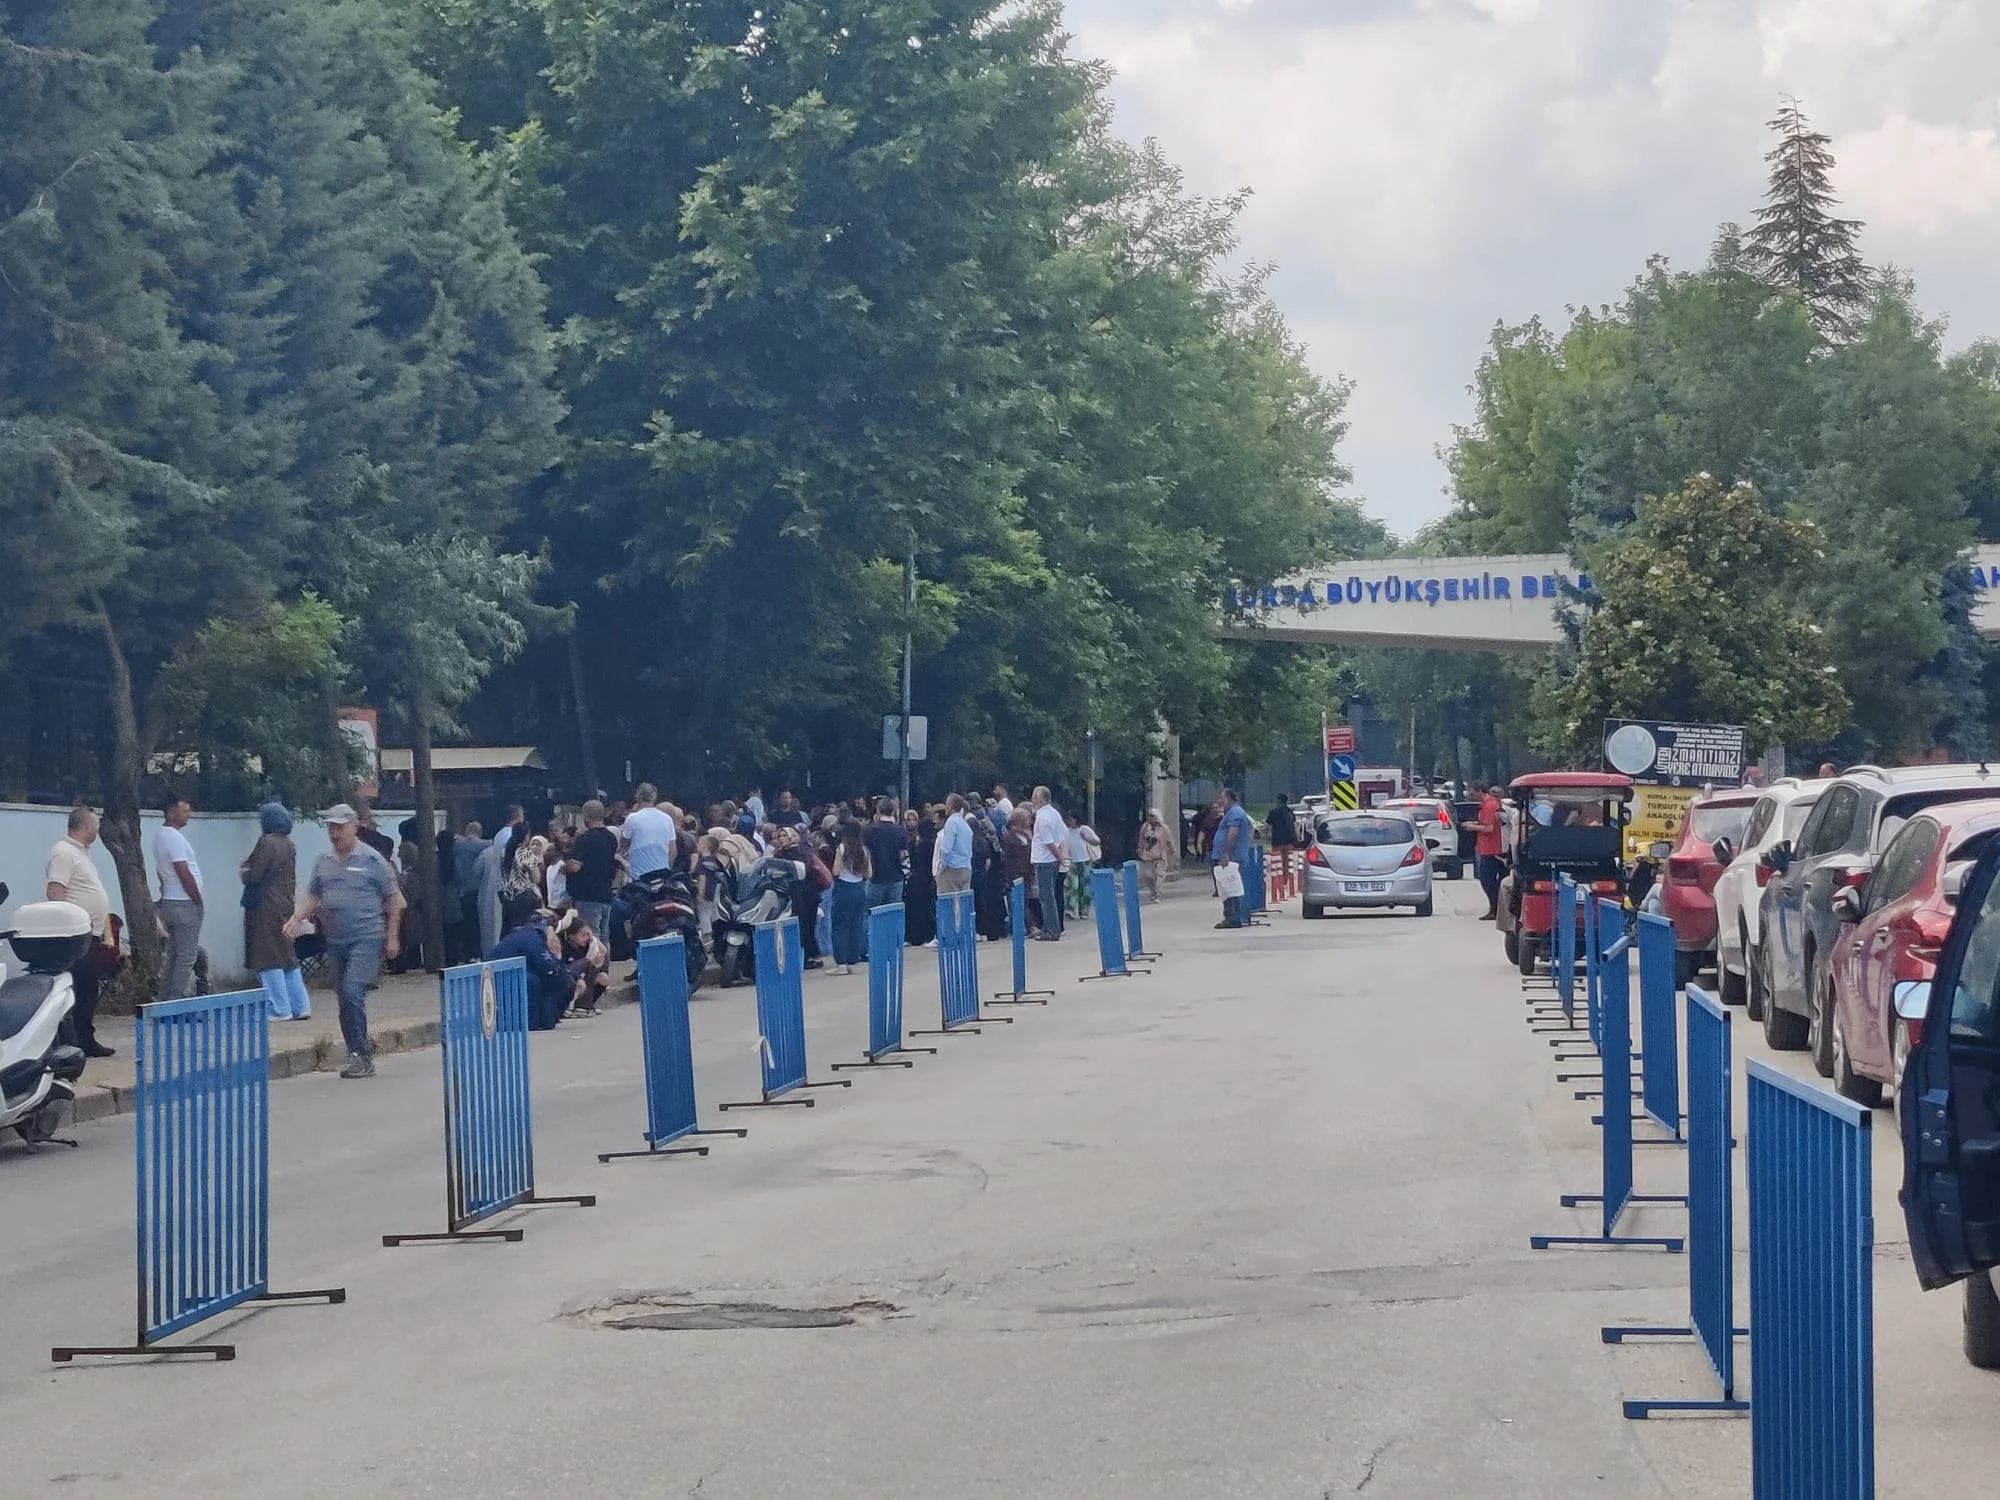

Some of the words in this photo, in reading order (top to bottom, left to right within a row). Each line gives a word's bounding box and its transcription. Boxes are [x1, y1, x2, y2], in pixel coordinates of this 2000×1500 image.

[1327, 571, 1511, 607] BÜYÜKŞEHİR
[1668, 761, 1690, 776] YERE
[1647, 802, 1677, 810] TURGUT
